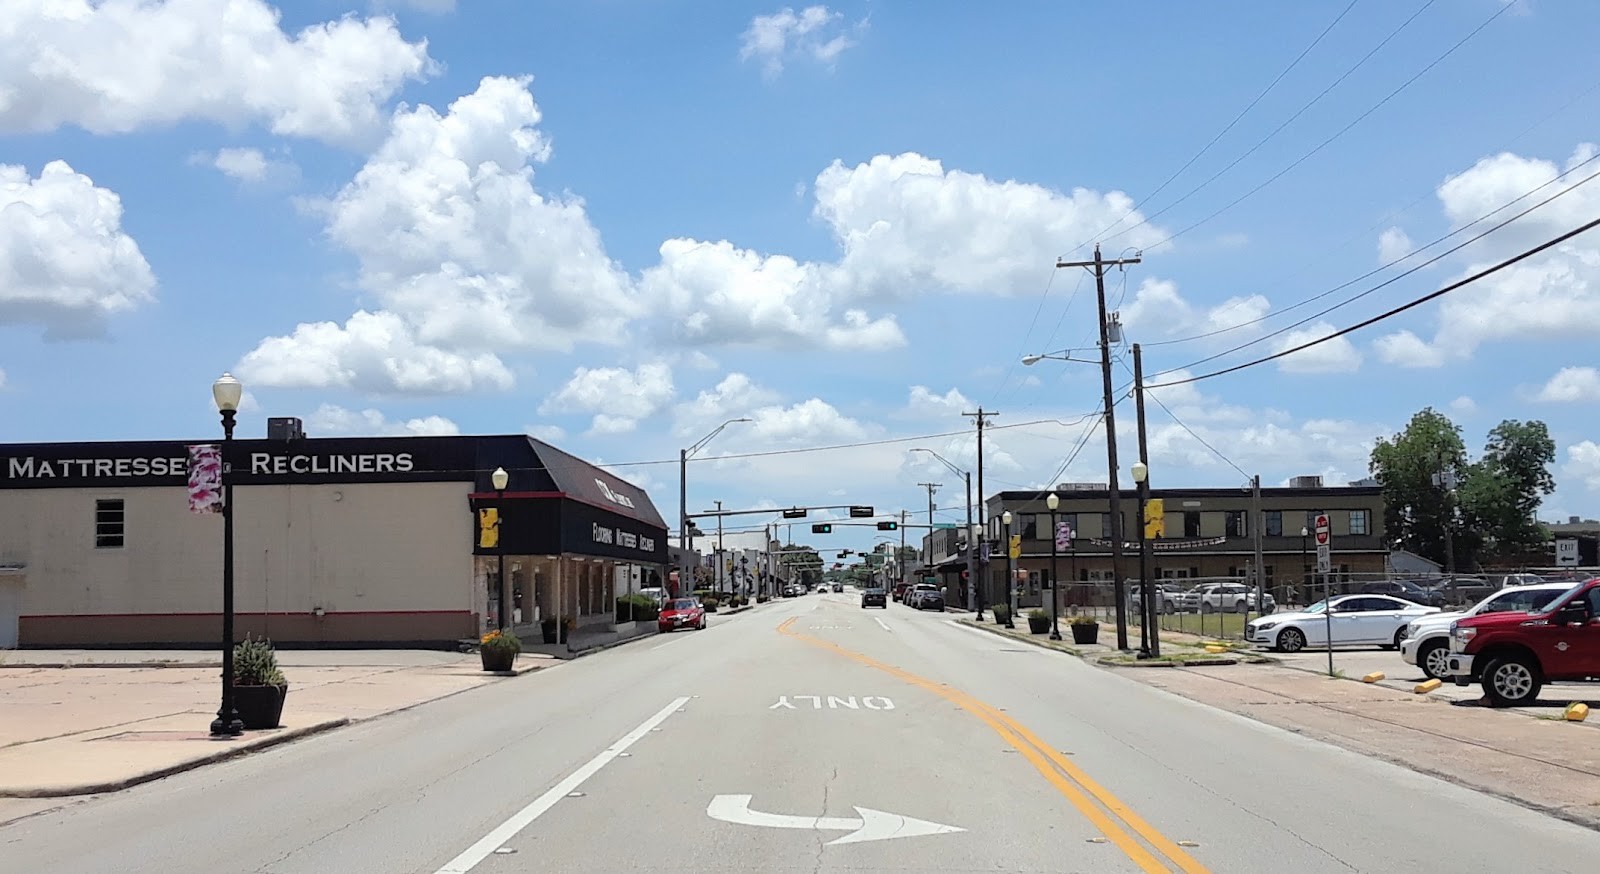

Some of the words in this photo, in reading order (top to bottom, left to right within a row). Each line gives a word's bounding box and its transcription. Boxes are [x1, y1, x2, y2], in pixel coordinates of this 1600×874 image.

[8, 457, 190, 478] MATTRESSE
[251, 453, 414, 474] RECLINERS
[1560, 543, 1576, 551] EXIT
[768, 695, 896, 710] ONLY
